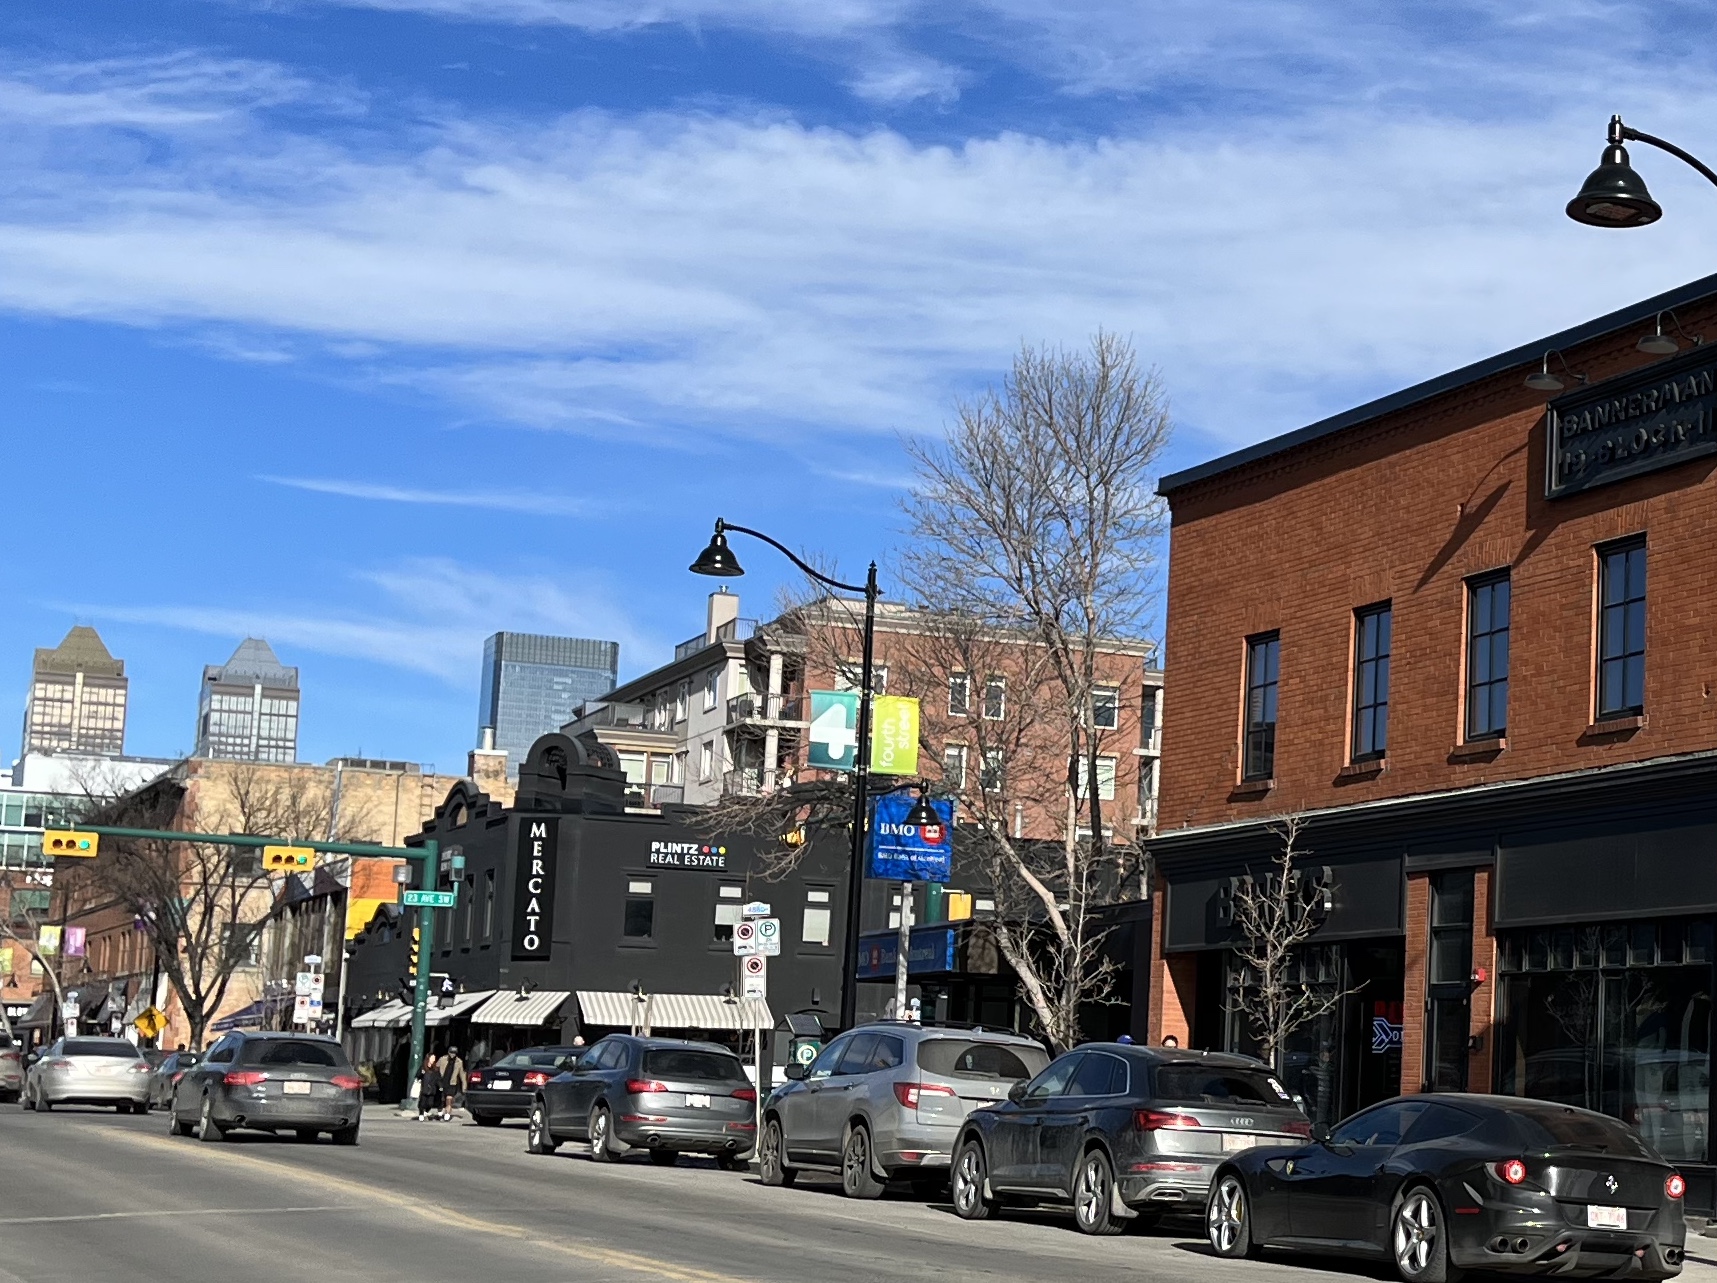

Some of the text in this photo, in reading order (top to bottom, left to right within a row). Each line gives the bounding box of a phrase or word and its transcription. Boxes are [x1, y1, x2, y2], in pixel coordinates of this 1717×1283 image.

[1563, 370, 1715, 437] BANNERMAN
[808, 703, 857, 760] 4
[878, 718, 896, 768] fourth
[895, 703, 911, 750] street
[651, 841, 699, 855] PLINTZ
[880, 822, 916, 837] BMO
[650, 853, 726, 868] REAL ESTATE
[407, 893, 451, 904] 23 AVE SW
[523, 822, 547, 951] MERCATO
